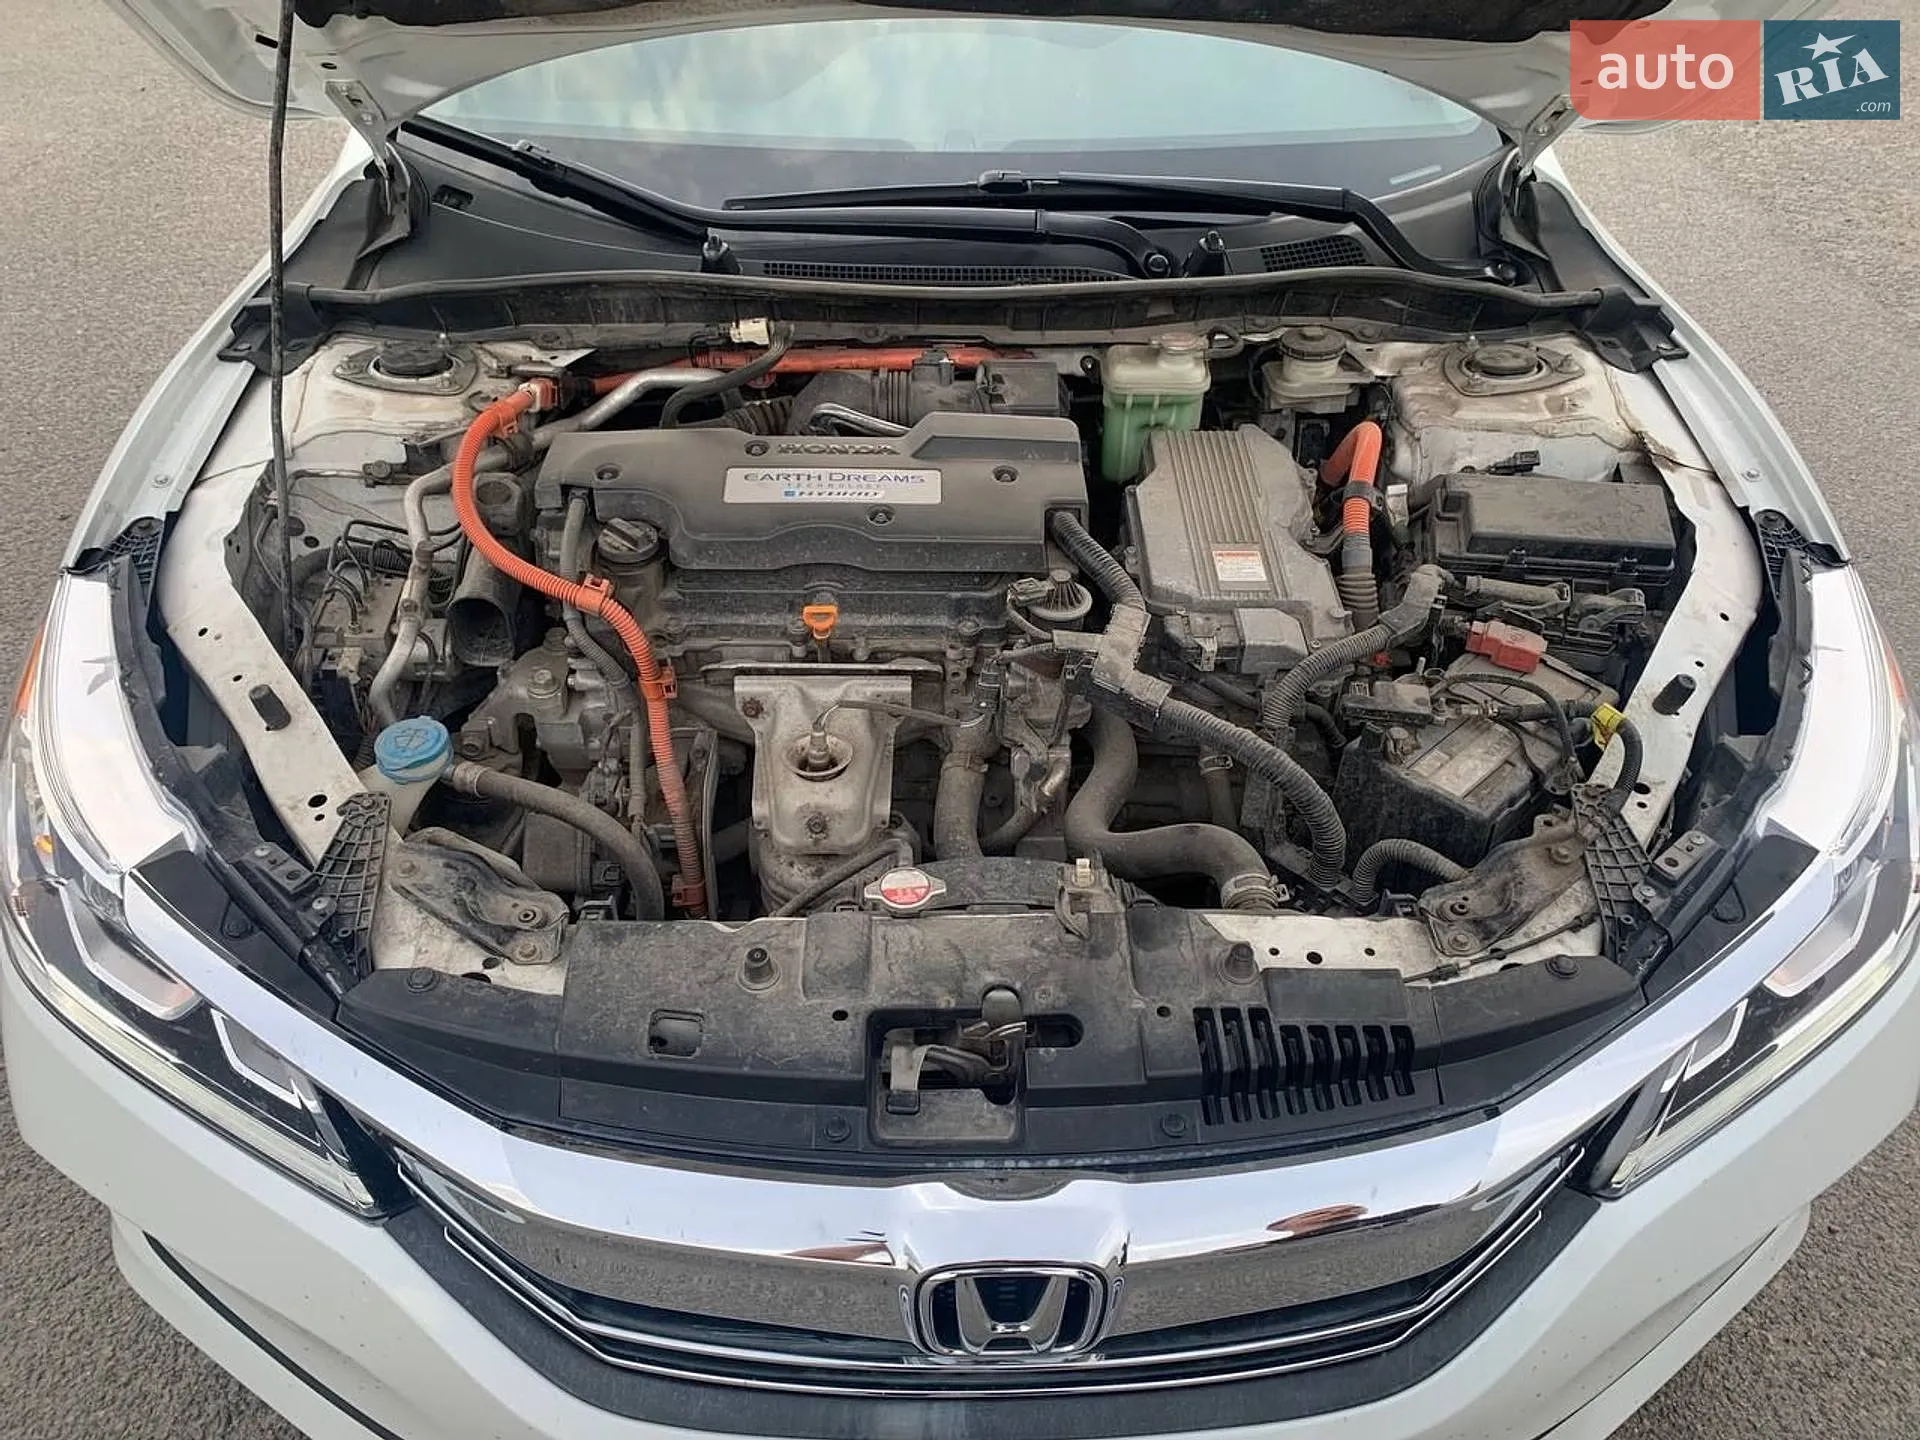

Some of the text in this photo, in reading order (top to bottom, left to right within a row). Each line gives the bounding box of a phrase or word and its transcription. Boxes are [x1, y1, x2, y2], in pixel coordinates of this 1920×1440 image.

[777, 443, 901, 455] HONDA
[744, 472, 925, 483] EARTH DREAMS
